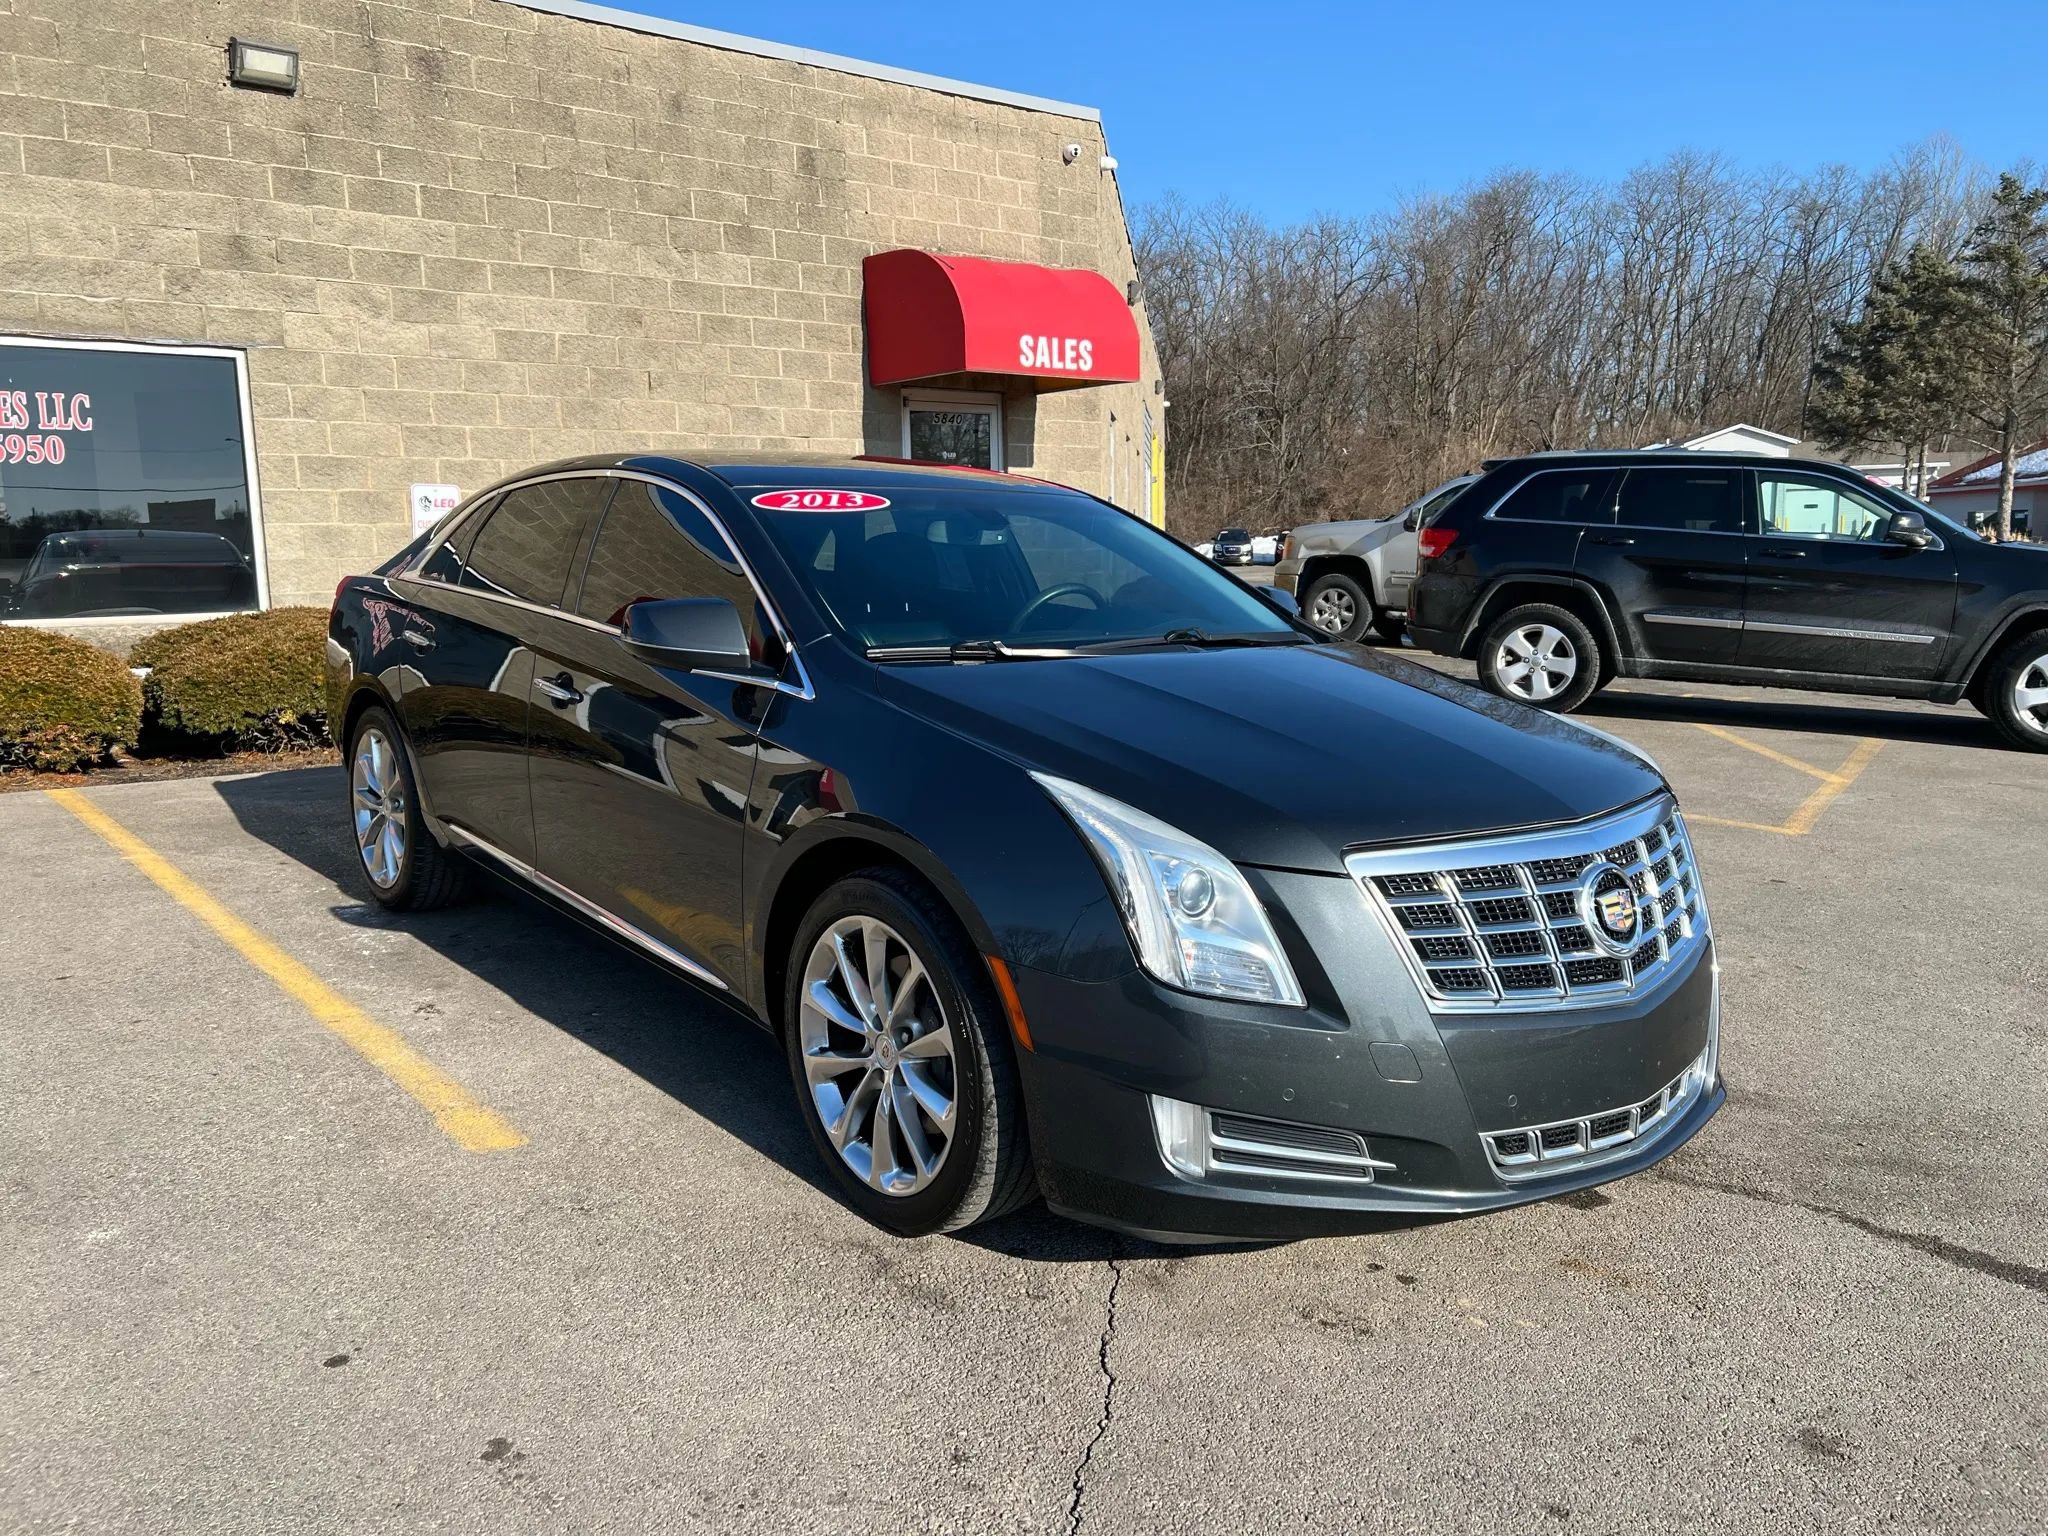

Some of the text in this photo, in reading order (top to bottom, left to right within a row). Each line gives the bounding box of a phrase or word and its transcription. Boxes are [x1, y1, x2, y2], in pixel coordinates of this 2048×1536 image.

[1019, 334, 1093, 371] SALES
[34, 392, 93, 431] LLC
[934, 413, 963, 425] 5840
[780, 493, 864, 508] 2013
